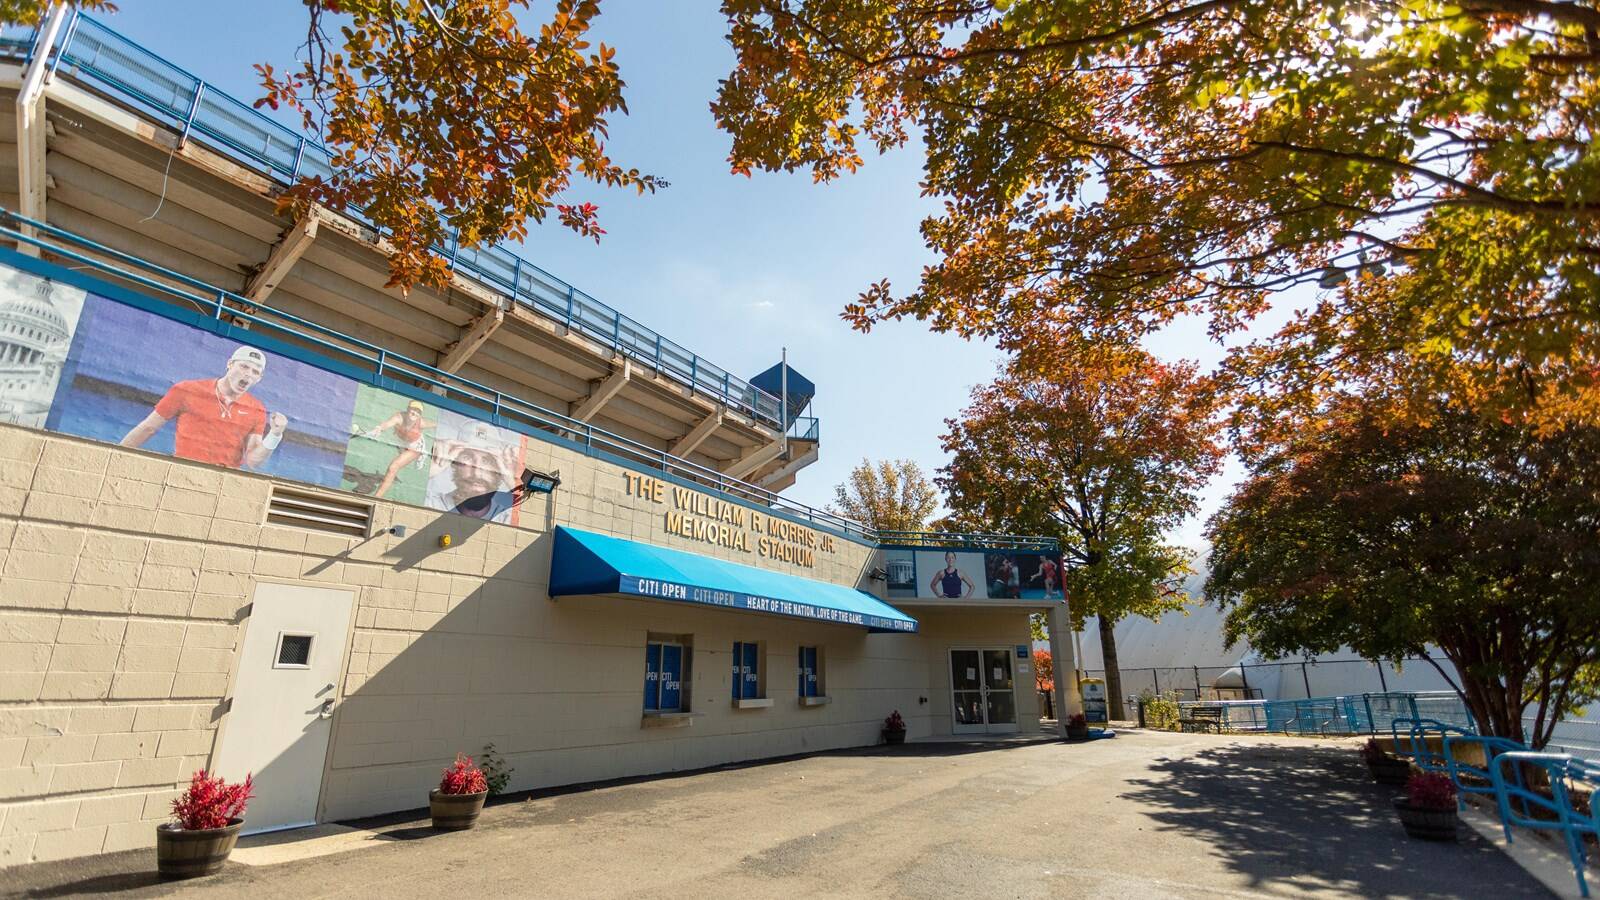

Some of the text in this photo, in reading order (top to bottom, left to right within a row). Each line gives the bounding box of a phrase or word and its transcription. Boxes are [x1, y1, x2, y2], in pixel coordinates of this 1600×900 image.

[623, 472, 835, 554] THE WILLIAM R. MORRIS, JR.
[664, 511, 816, 568] MEMORIAL STADIUM
[638, 579, 686, 599] CITI OPEN
[694, 588, 734, 606] CITI OPEN
[747, 596, 863, 624] HEART OF THE NATION. LOVE OF THE GAME.
[665, 681, 680, 690] OPEN
